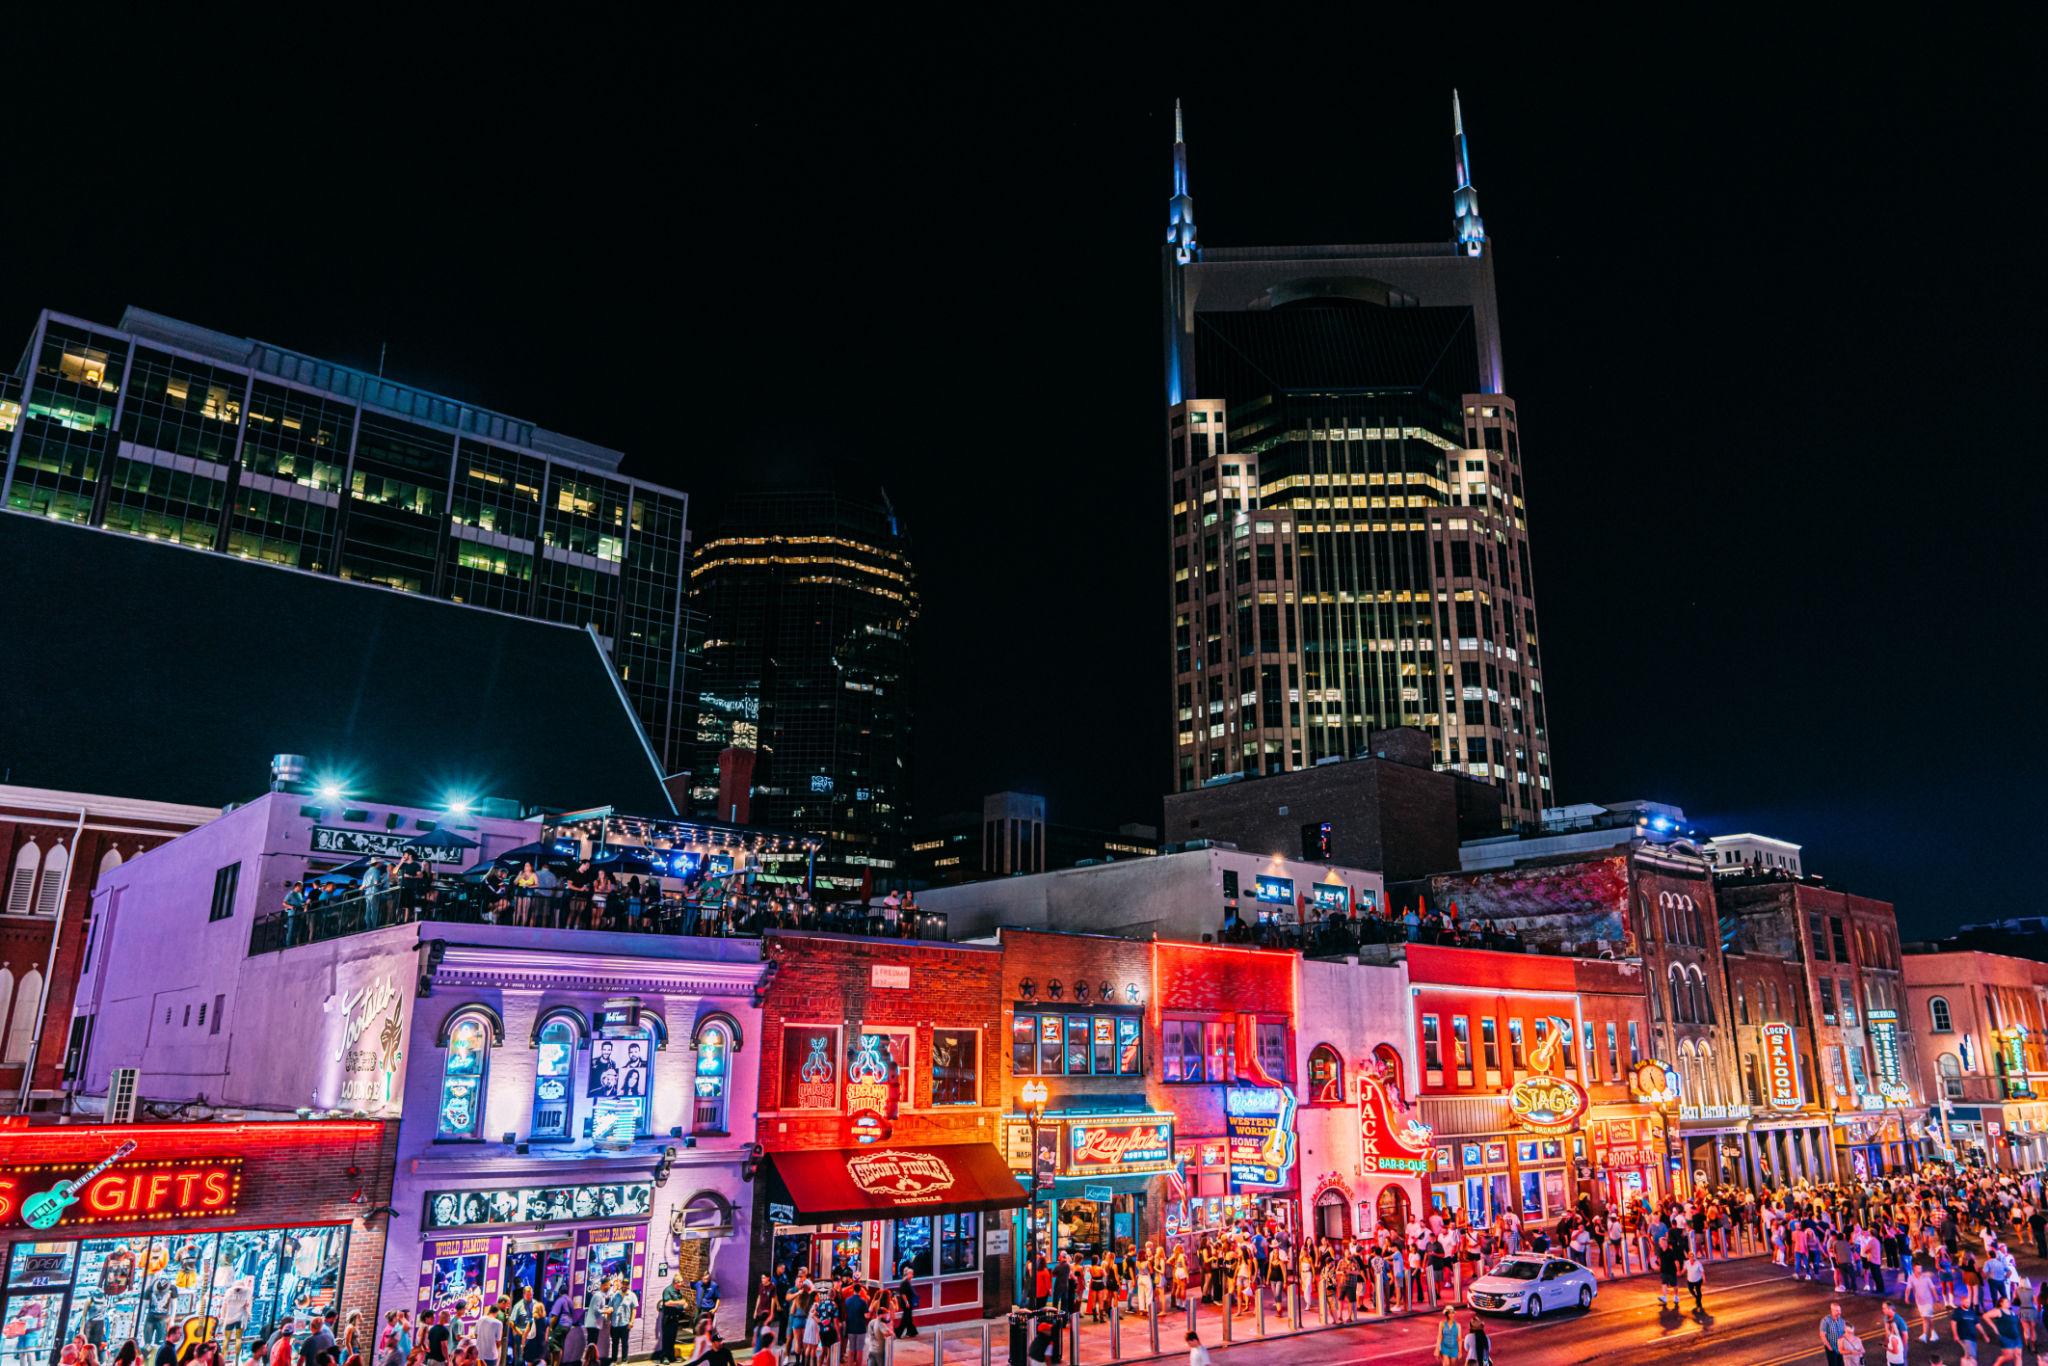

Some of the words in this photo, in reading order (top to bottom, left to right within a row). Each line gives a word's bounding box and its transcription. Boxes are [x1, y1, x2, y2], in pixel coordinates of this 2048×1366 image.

[1764, 1026, 1789, 1035] LUCKY
[1877, 1023, 1897, 1085] WHISKEY
[1770, 1035, 1792, 1098] SALOON
[341, 1079, 381, 1101] LOUNGE
[847, 1083, 889, 1100] SECOND
[1512, 1083, 1577, 1115] STAGE
[848, 1098, 887, 1116] FIDDLE
[1229, 1117, 1277, 1128] WESTERN
[1235, 1127, 1270, 1136] WORLD
[1361, 1085, 1380, 1172] JACKS
[1078, 1126, 1168, 1165] Layla's
[1231, 1137, 1259, 1147] HOME
[1379, 1158, 1428, 1172] BAR-B-QUE
[1608, 1149, 1636, 1167] BOOTS
[854, 1161, 901, 1187] SECOND
[898, 1159, 948, 1182] FIDDLE
[90, 1172, 227, 1211] GIFTS
[893, 1195, 943, 1205] NASHVILLE
[588, 1228, 611, 1242] WORLD
[611, 1225, 637, 1241] FAMOUS
[435, 1240, 461, 1257] WORLD
[461, 1237, 490, 1254] FAMOUS
[28, 1258, 62, 1271] OPEN
[32, 1277, 49, 1287] 424
